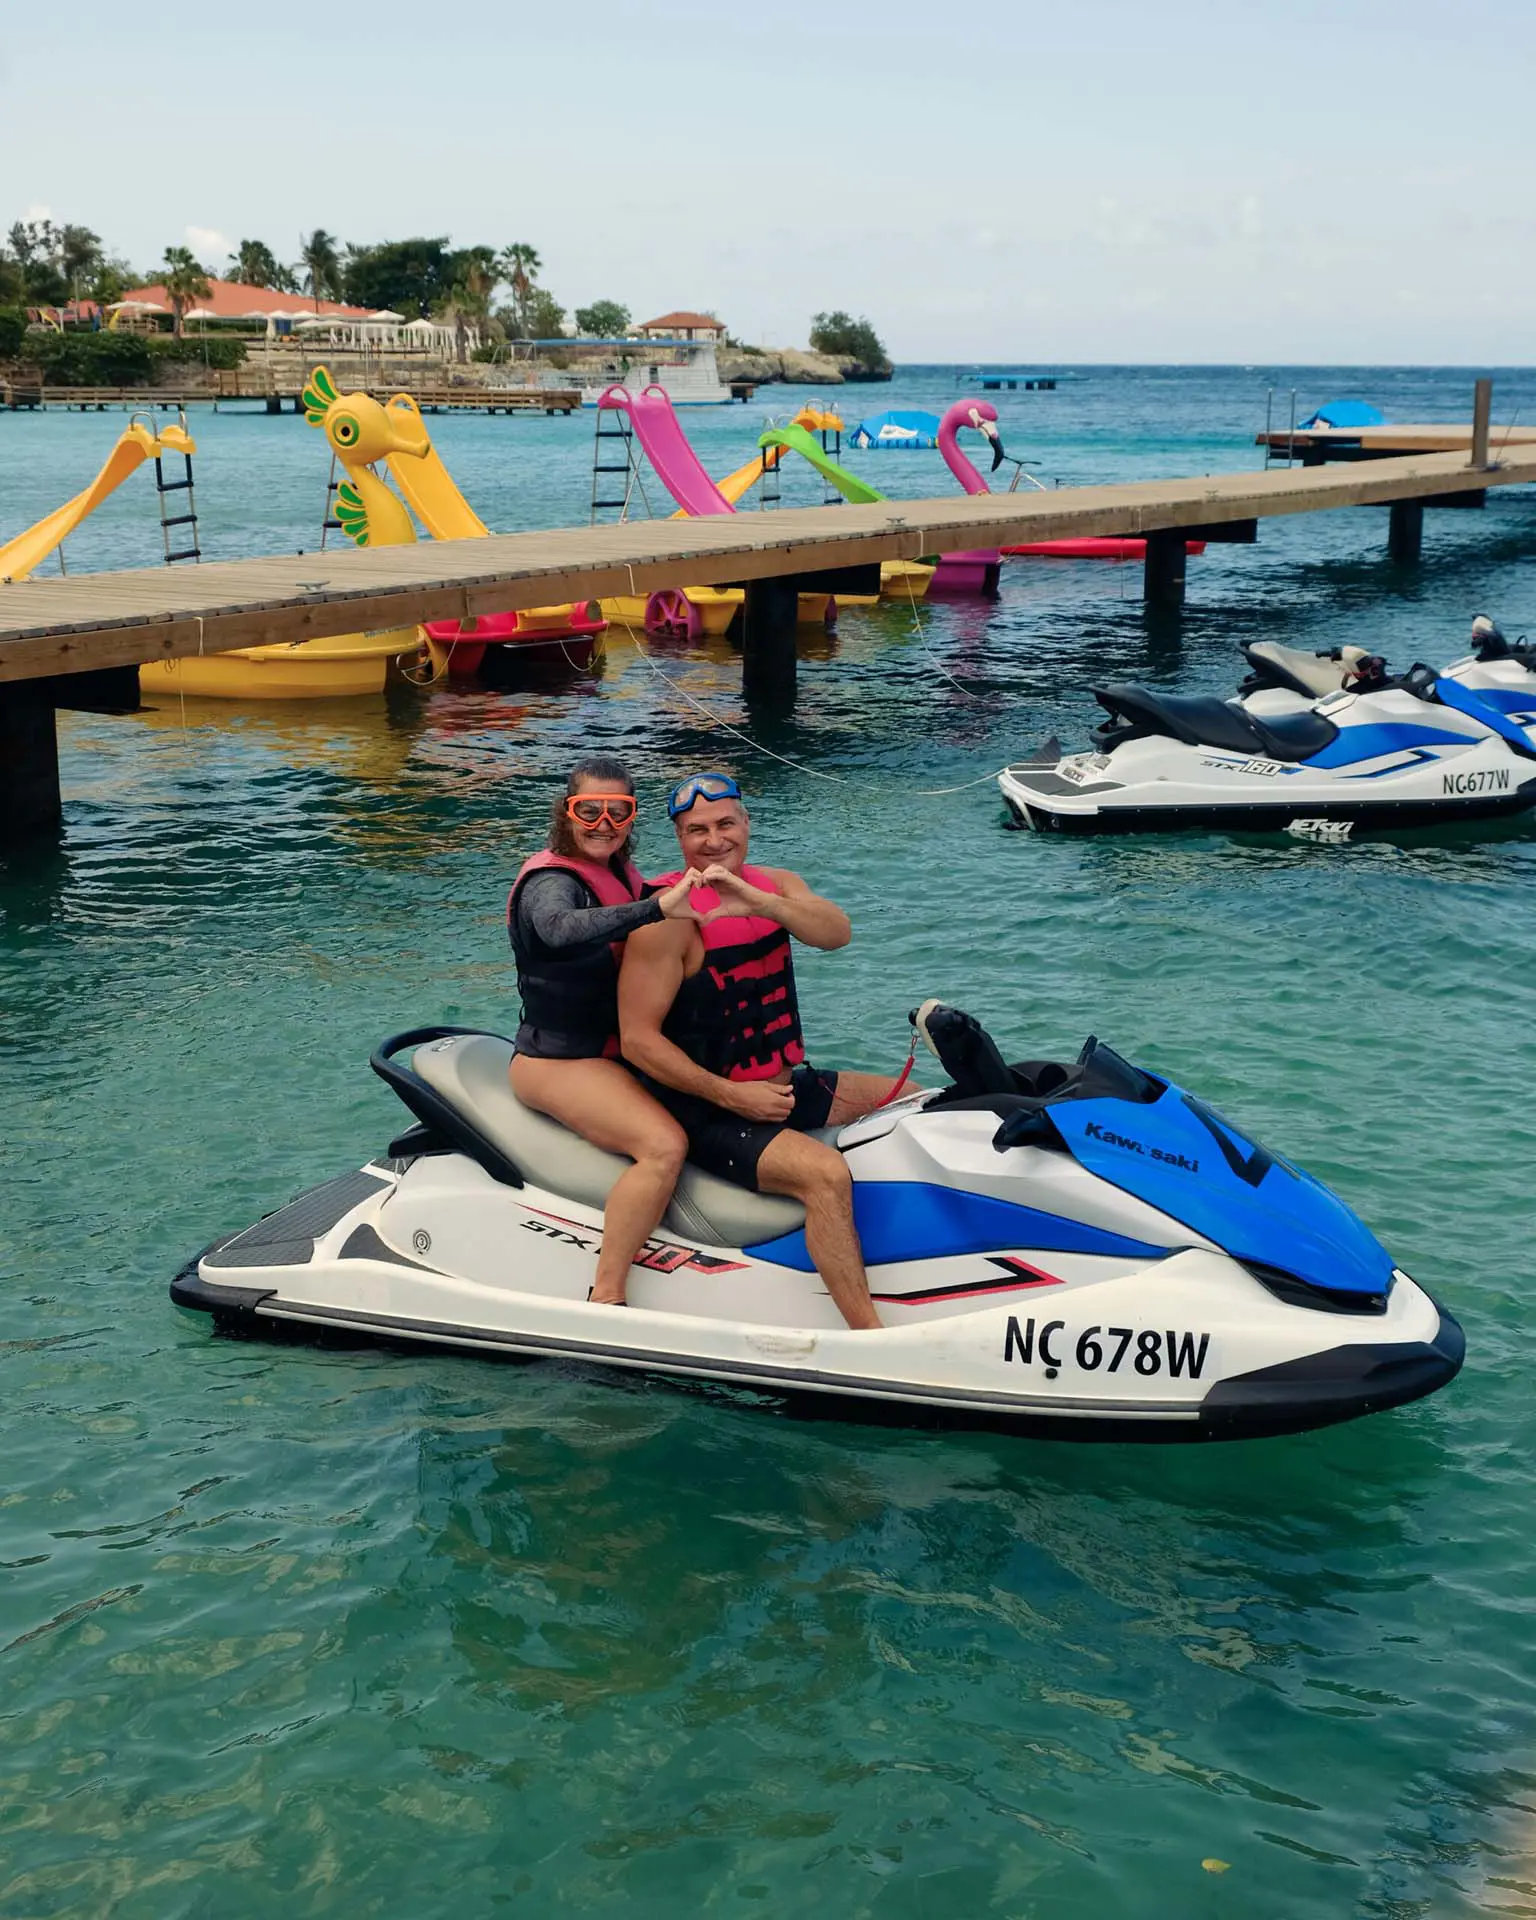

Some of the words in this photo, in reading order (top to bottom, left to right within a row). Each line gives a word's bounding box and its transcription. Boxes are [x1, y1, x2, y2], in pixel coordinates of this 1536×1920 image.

[1239, 759, 1282, 777] 160
[519, 1220, 595, 1250] STX
[1004, 1316, 1066, 1368] NC
[1076, 1326, 1210, 1379] 678W
